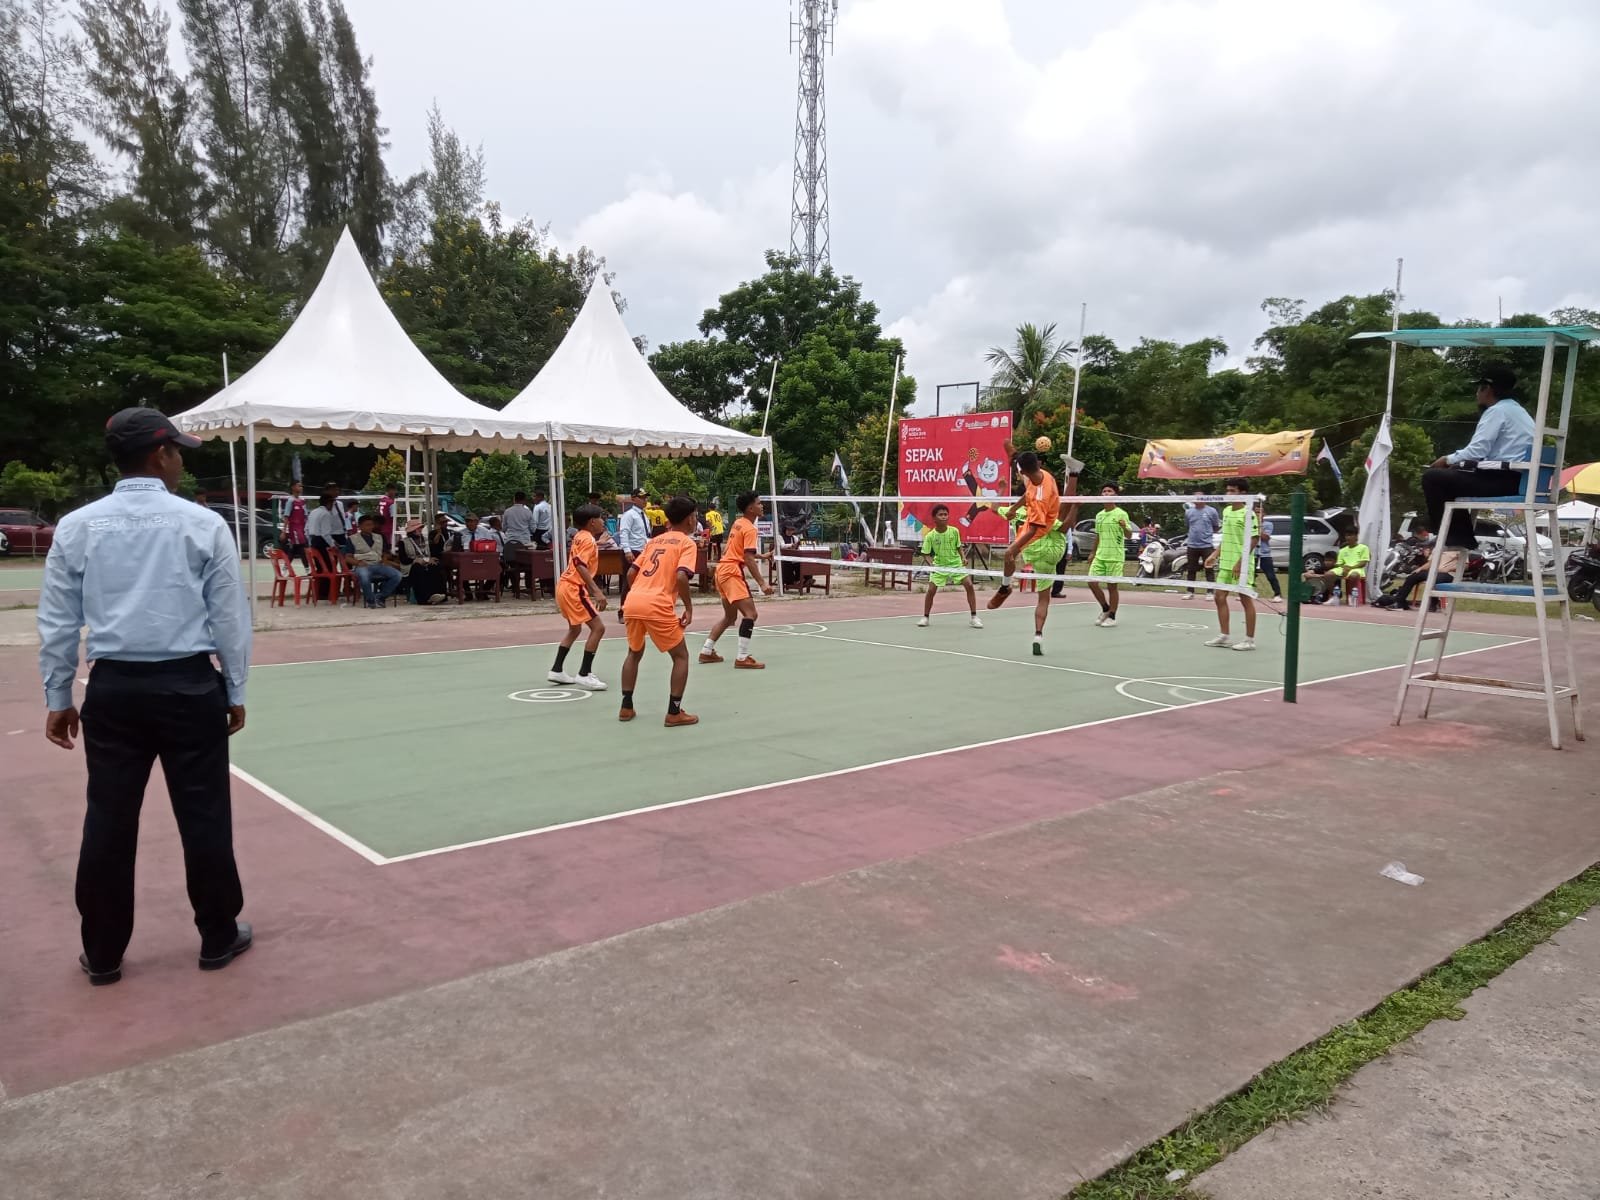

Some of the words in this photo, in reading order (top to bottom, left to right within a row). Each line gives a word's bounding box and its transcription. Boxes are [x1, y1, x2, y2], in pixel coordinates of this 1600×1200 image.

[905, 447, 944, 462] SEPAK
[904, 468, 958, 482] TAKRAW
[643, 549, 666, 577] 5
